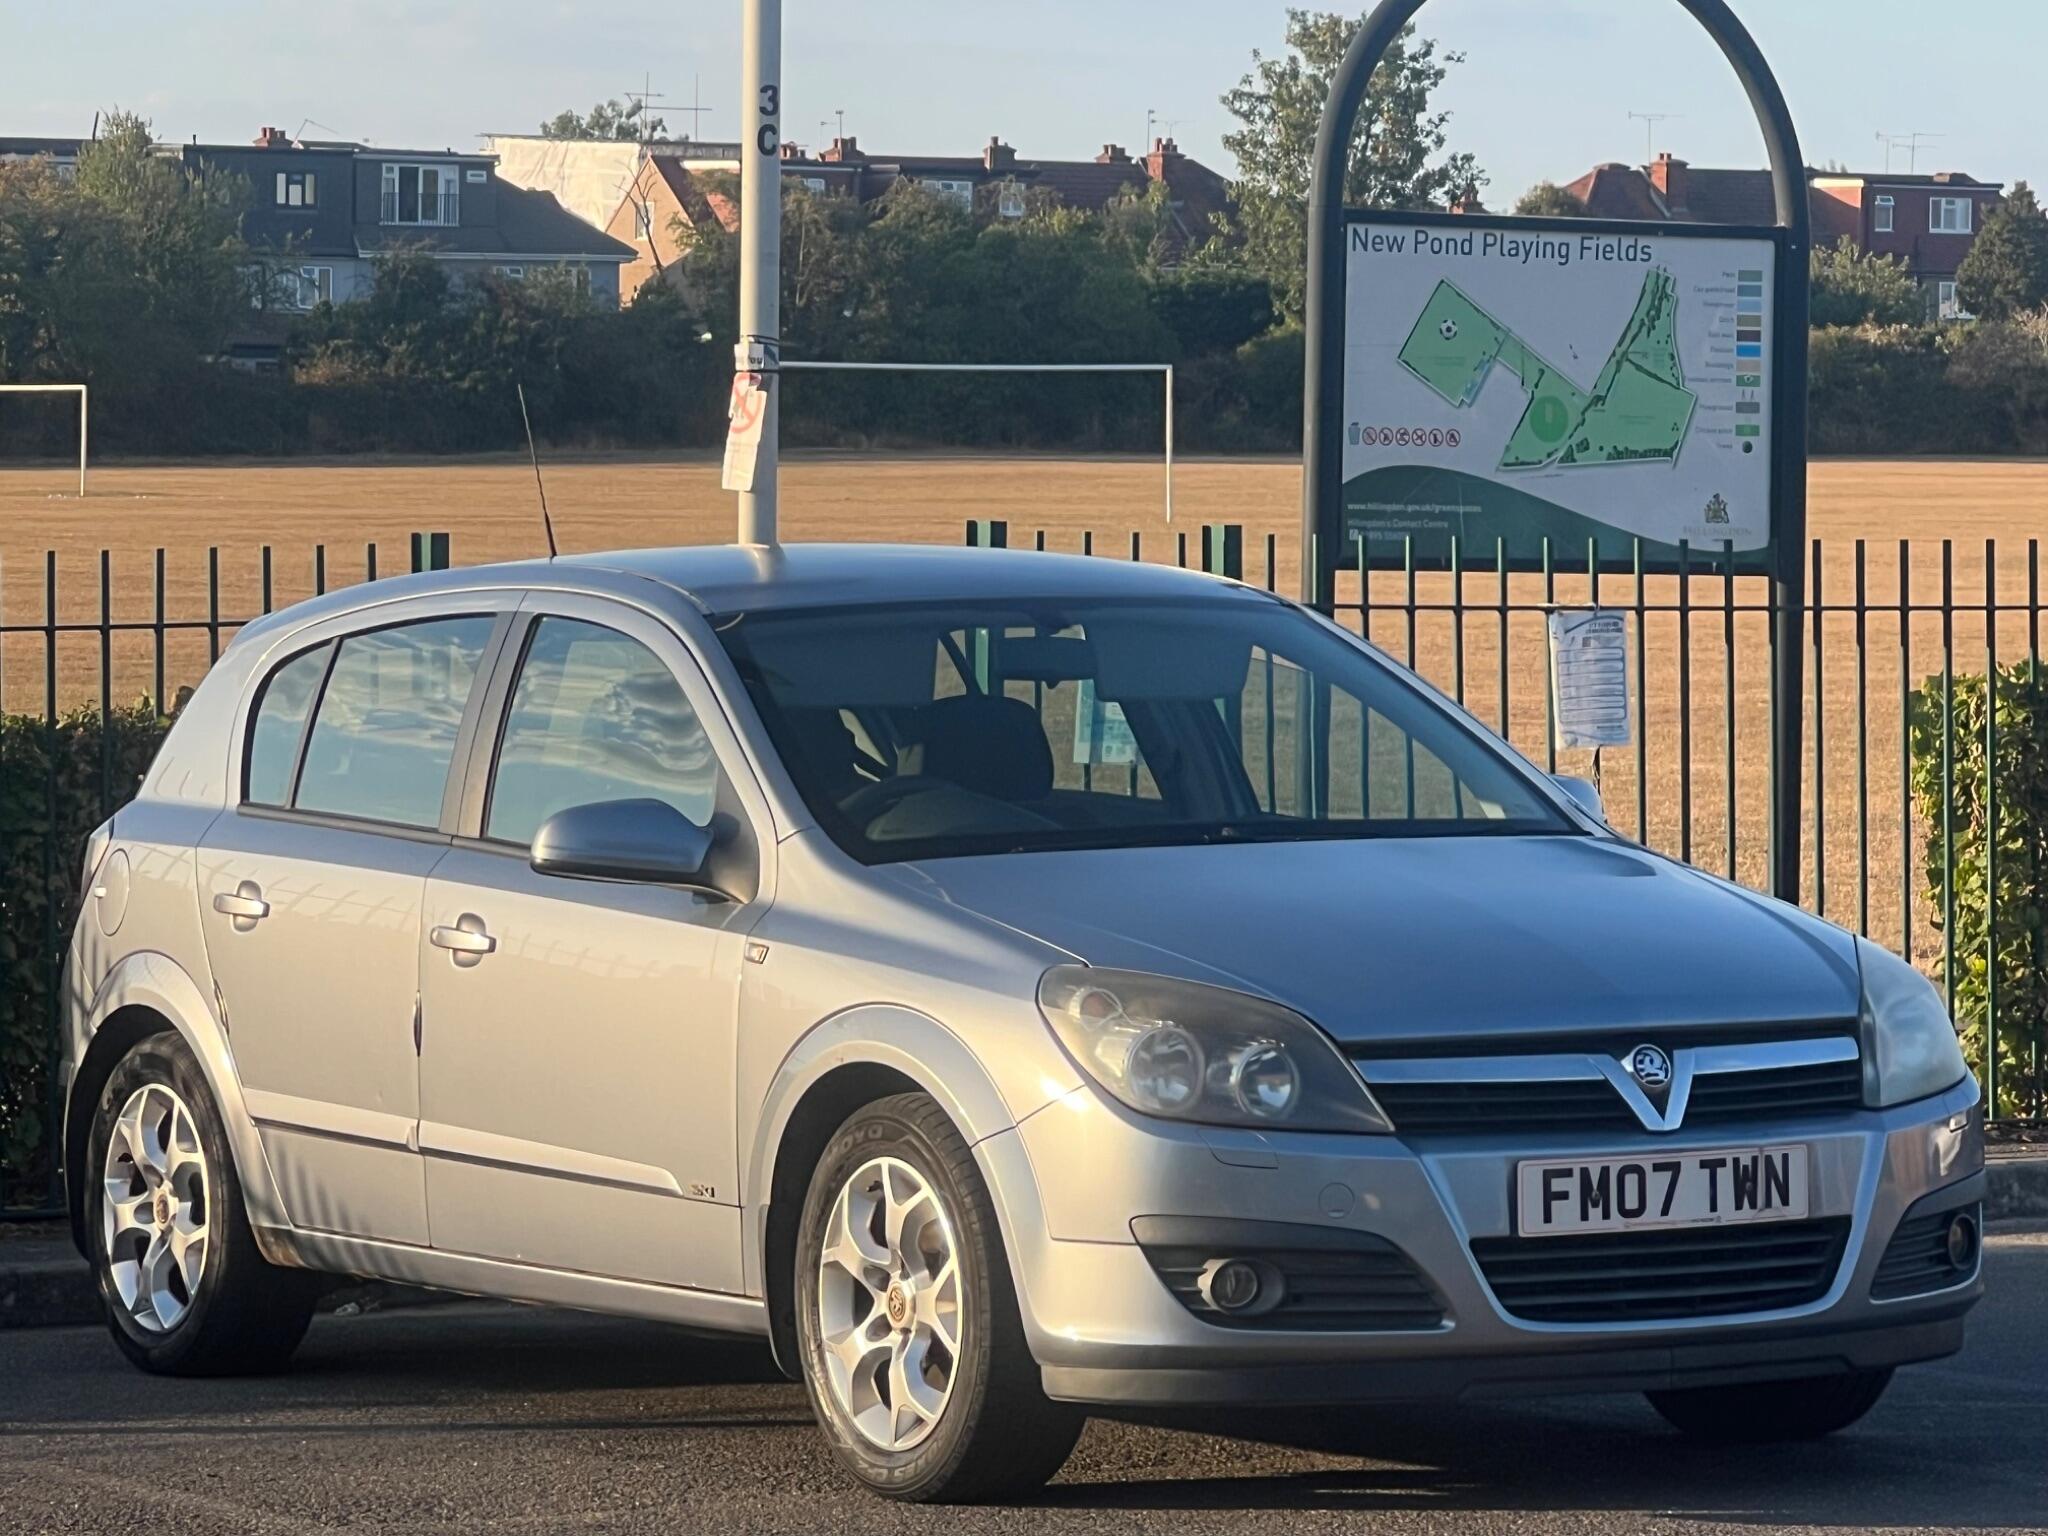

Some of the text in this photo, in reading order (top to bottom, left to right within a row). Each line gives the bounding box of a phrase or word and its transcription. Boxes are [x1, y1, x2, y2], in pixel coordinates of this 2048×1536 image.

[759, 84, 778, 116] 3
[757, 123, 778, 156] C
[1352, 227, 1653, 266] New Pond Playing Fields
[1542, 1152, 1791, 1224] FM07 TWN
